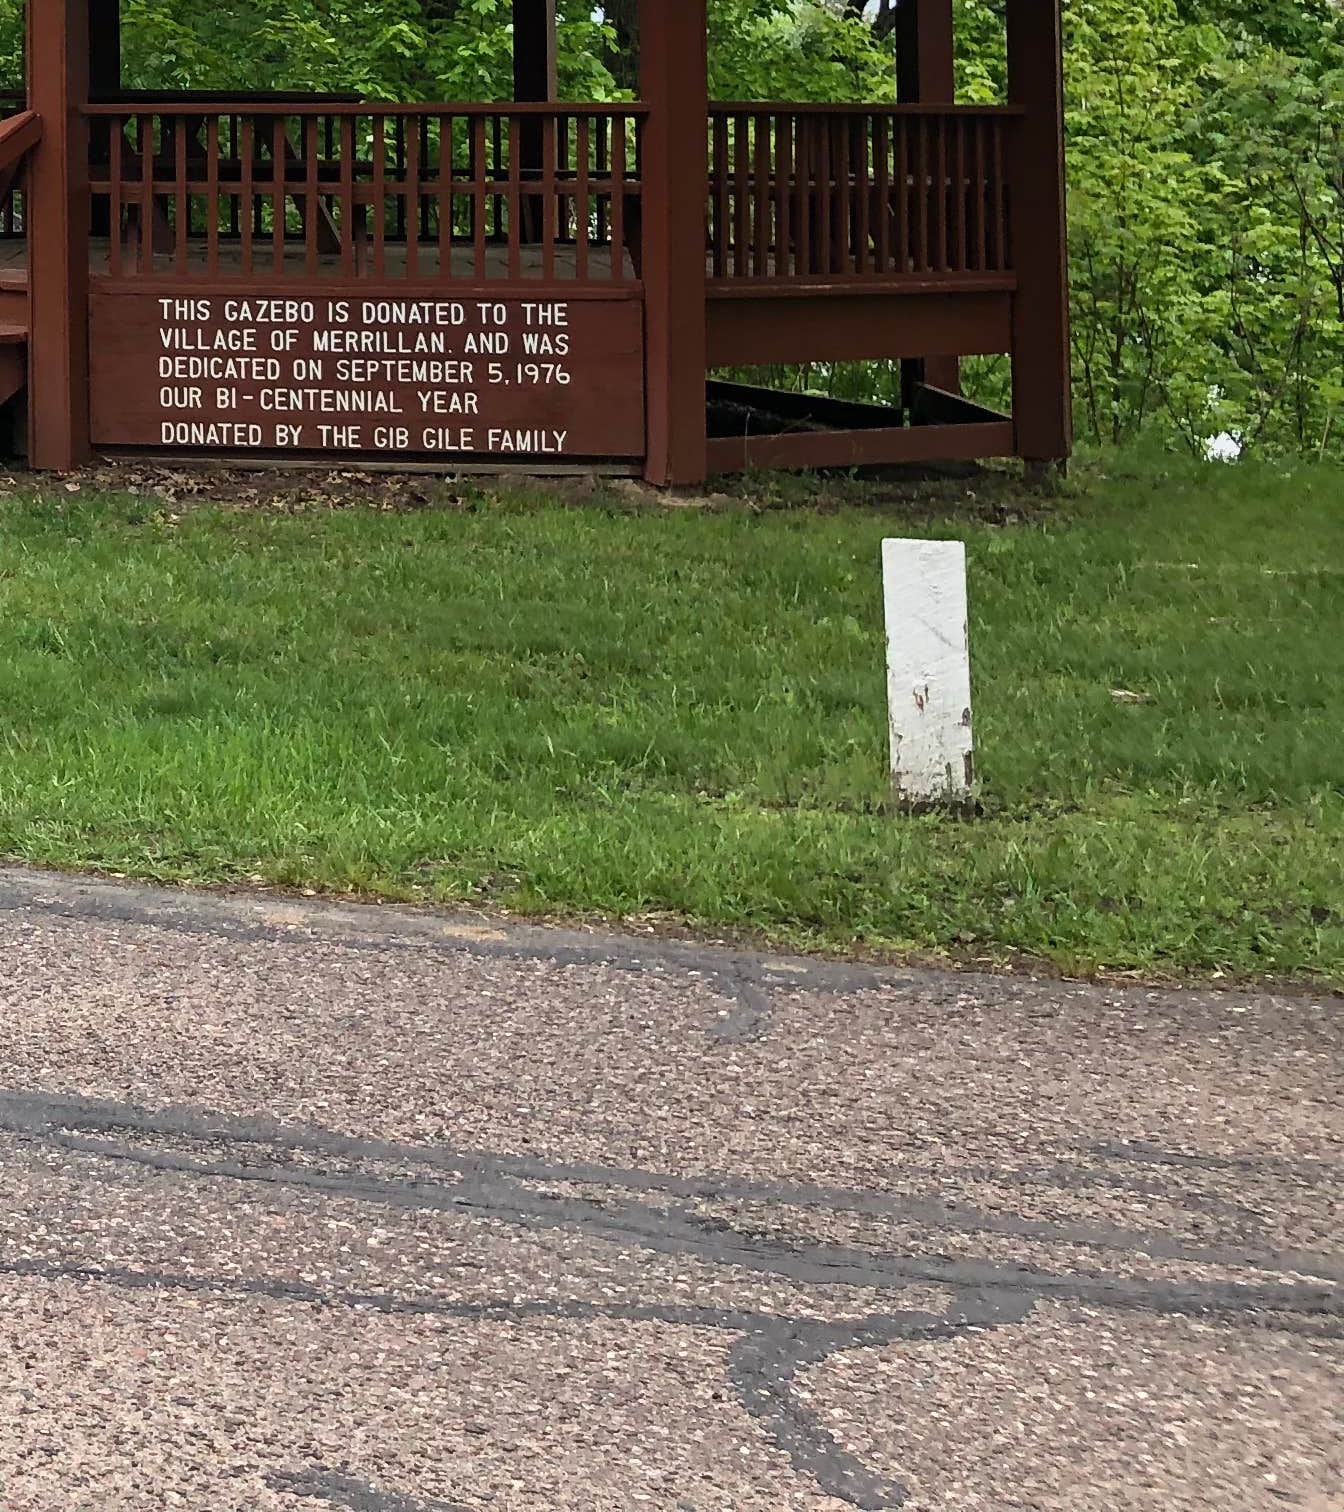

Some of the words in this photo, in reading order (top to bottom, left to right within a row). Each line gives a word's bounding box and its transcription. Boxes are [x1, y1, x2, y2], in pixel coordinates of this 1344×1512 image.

[158, 298, 211, 321] THIS
[224, 300, 314, 323] GAZEBO
[328, 301, 349, 324] IS
[362, 302, 464, 325] DONATED
[476, 303, 507, 325] TO
[520, 303, 568, 326] THE
[159, 328, 257, 351] VILLAGE
[270, 330, 299, 351] OF
[464, 332, 509, 354] AND
[522, 333, 569, 356] WAS
[159, 356, 280, 380] DEDICATED
[293, 359, 322, 381] ON
[336, 359, 473, 384] SEPTEMBER
[160, 386, 202, 409] OUR
[417, 390, 479, 414] YEAR
[161, 422, 262, 446] DONATED
[275, 424, 303, 446] BY
[316, 425, 362, 448] THE
[374, 426, 409, 449] GIB
[422, 427, 474, 451] GILE
[488, 428, 567, 452] FAMILY
